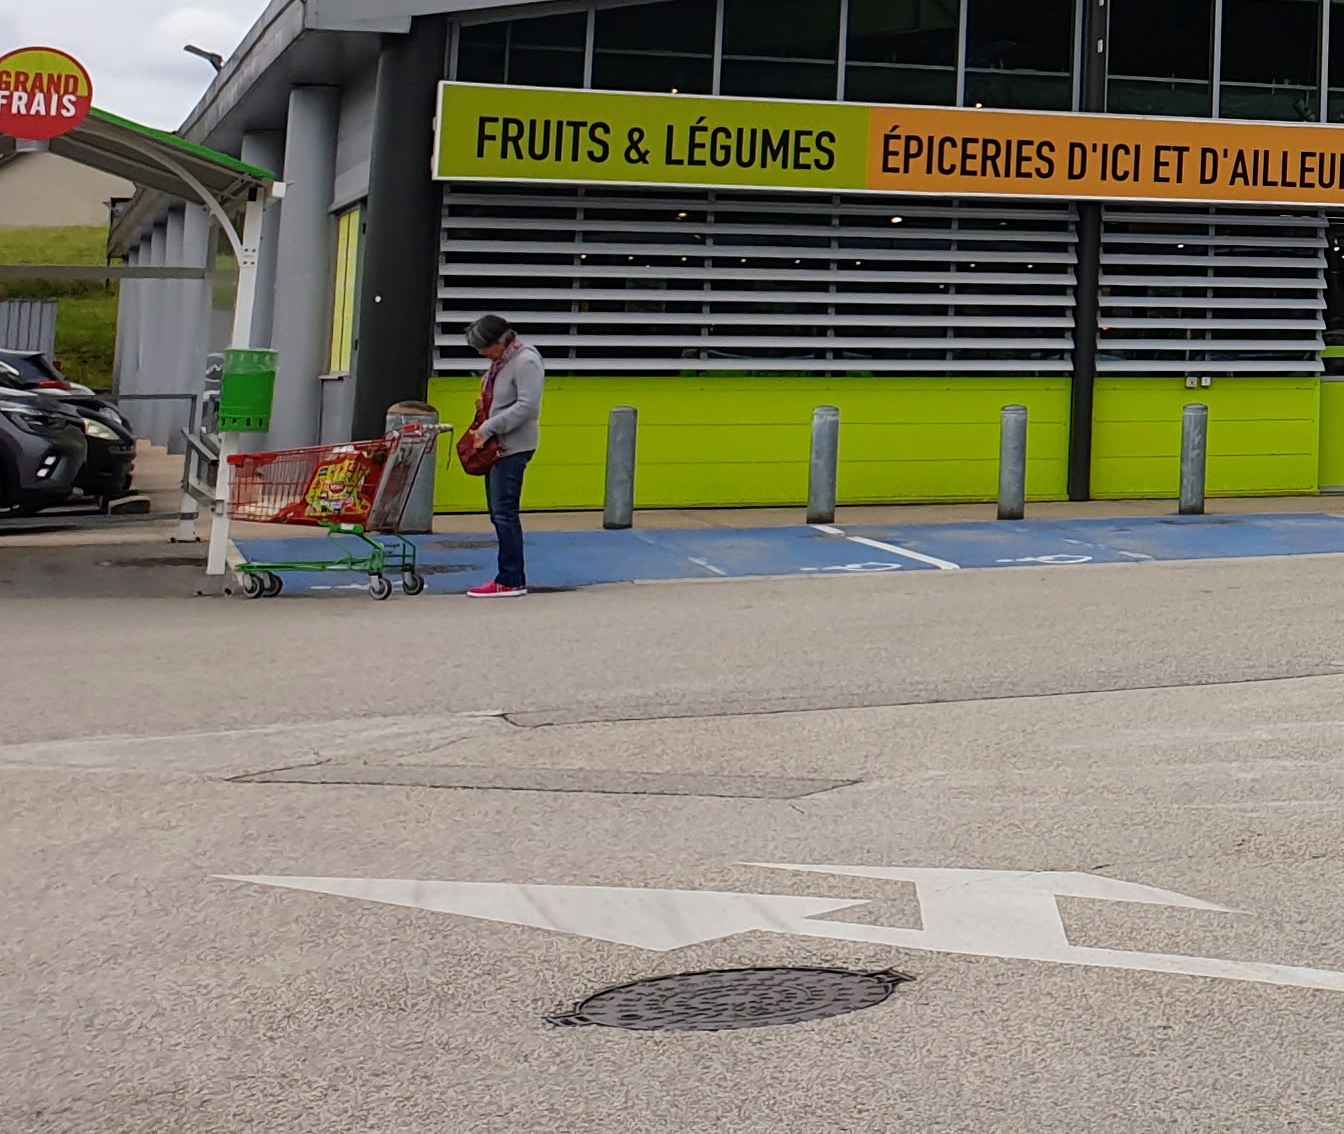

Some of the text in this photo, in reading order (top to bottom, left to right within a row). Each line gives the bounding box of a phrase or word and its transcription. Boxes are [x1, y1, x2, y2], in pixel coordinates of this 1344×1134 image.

[476, 116, 837, 171] FRUITS & LÉGUMES
[882, 125, 1056, 179] ÉPICERIES
[1067, 142, 1141, 183] D'ICI
[1153, 145, 1190, 185] ET
